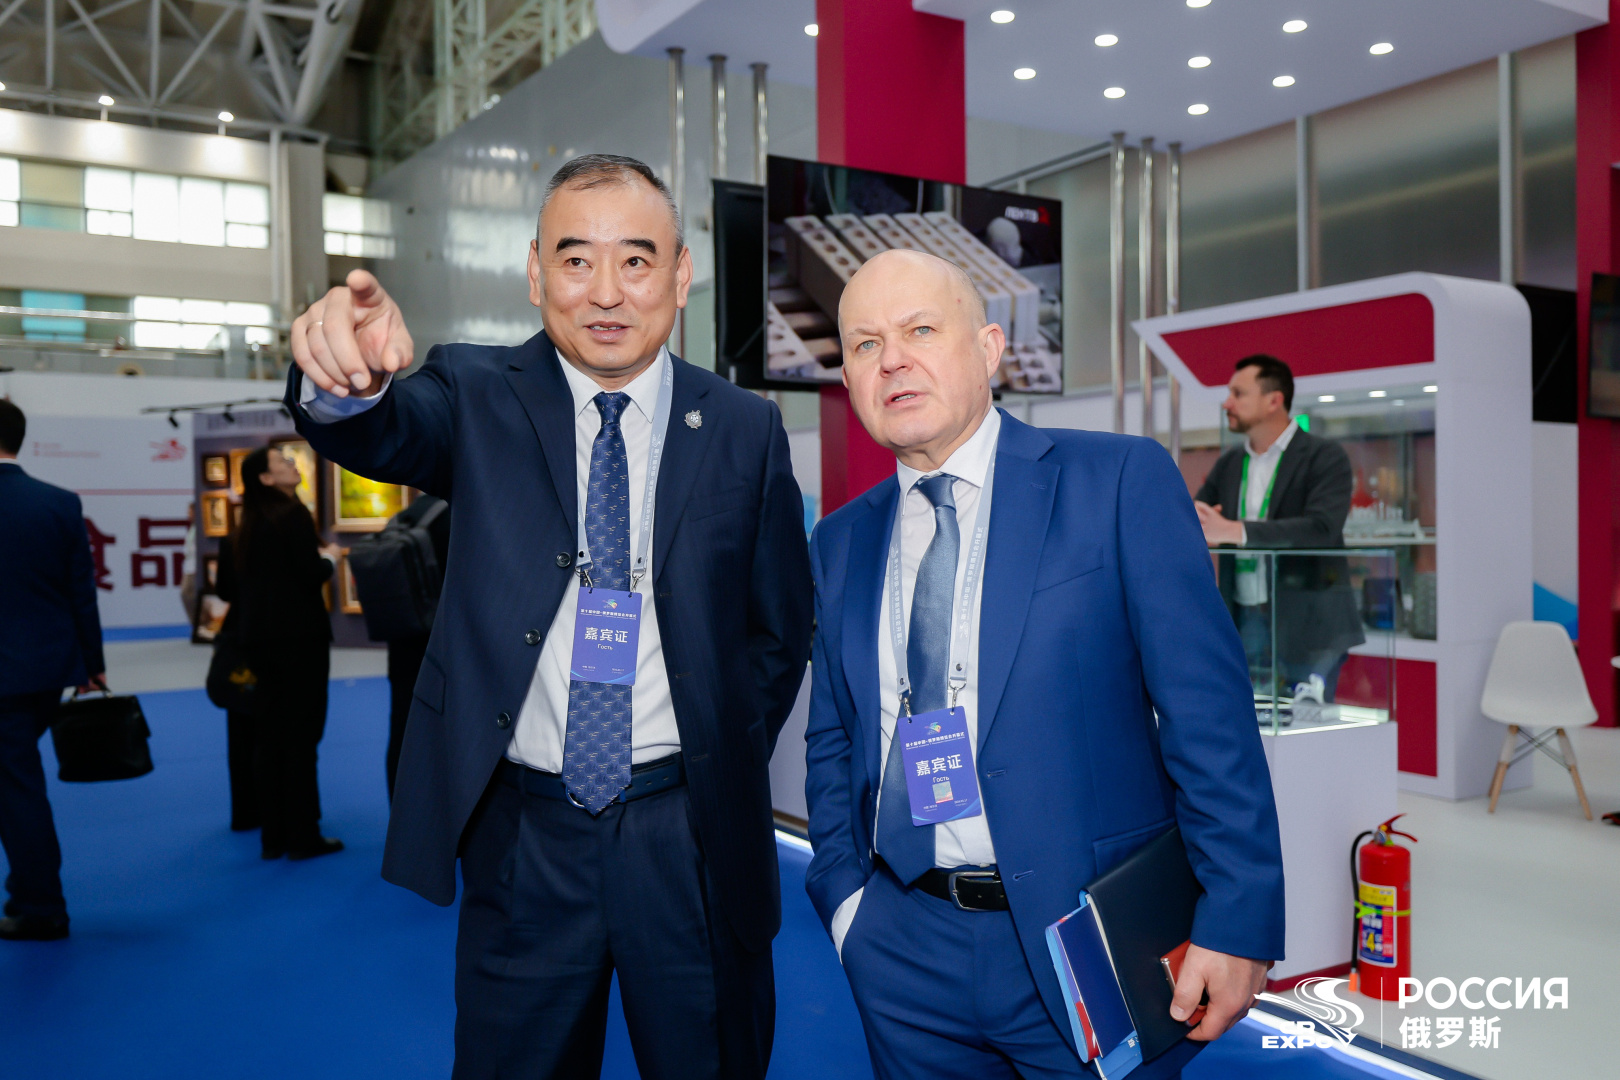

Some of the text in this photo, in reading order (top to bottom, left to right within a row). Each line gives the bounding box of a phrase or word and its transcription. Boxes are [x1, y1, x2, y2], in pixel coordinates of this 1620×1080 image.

[585, 627, 628, 643] 嘉宾证
[915, 754, 962, 776] 嘉宾证
